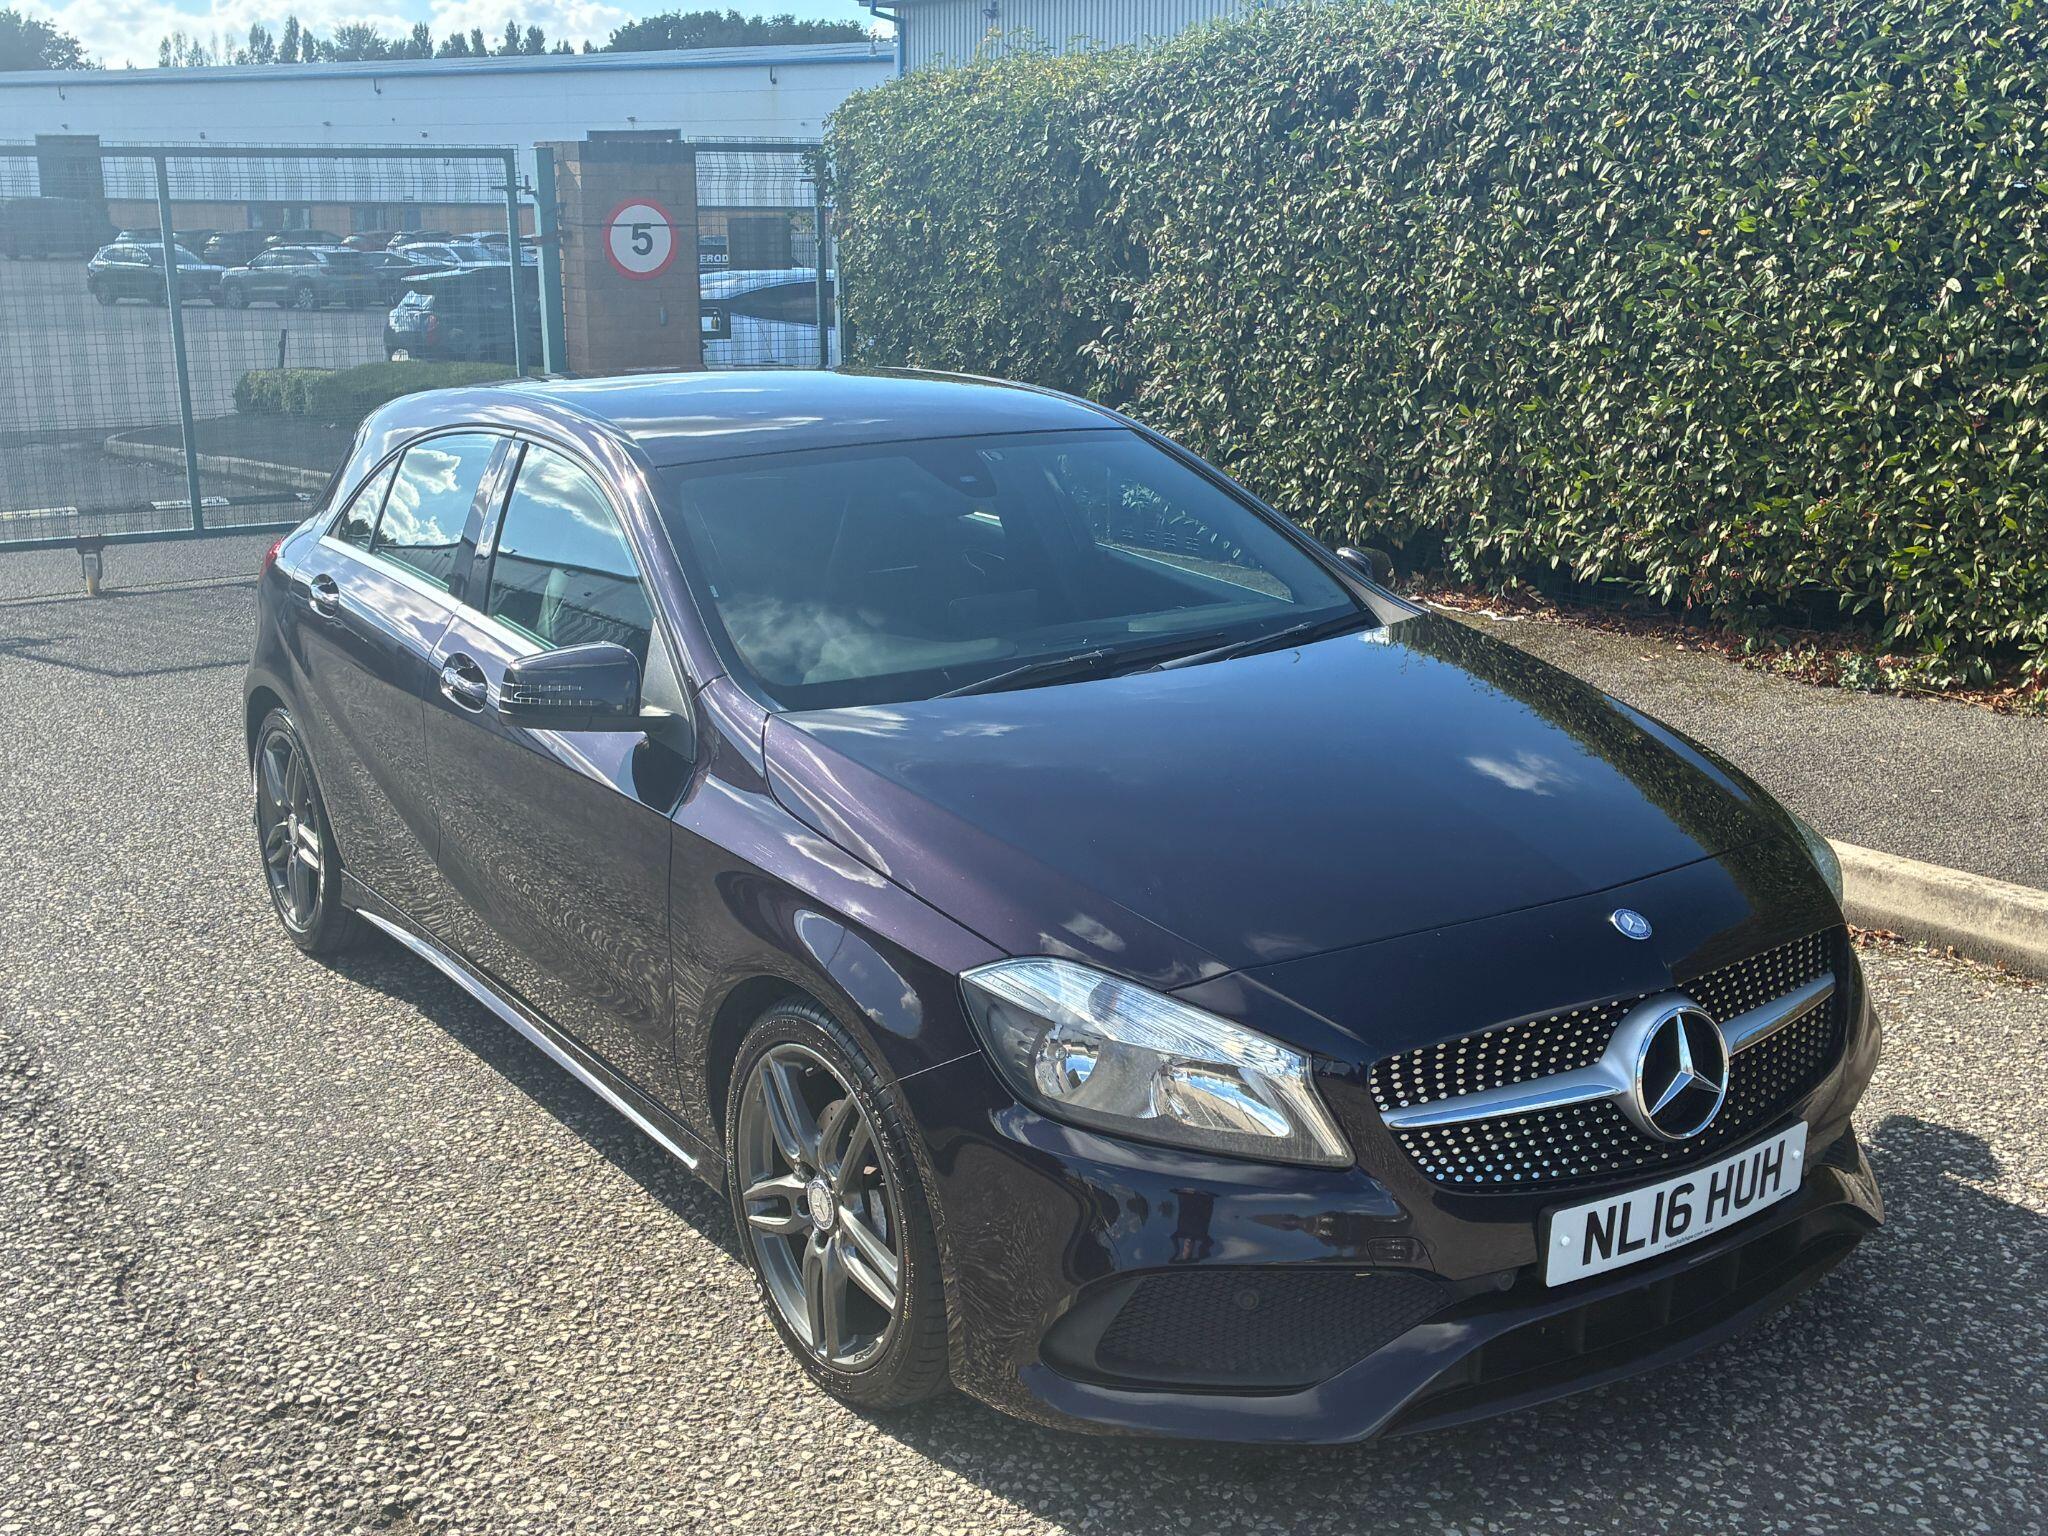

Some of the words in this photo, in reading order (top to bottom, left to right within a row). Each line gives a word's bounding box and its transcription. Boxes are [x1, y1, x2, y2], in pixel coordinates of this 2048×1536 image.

[632, 223, 653, 255] 5
[1582, 1182, 1695, 1266] NL16
[1705, 1140, 1786, 1224] HUH
